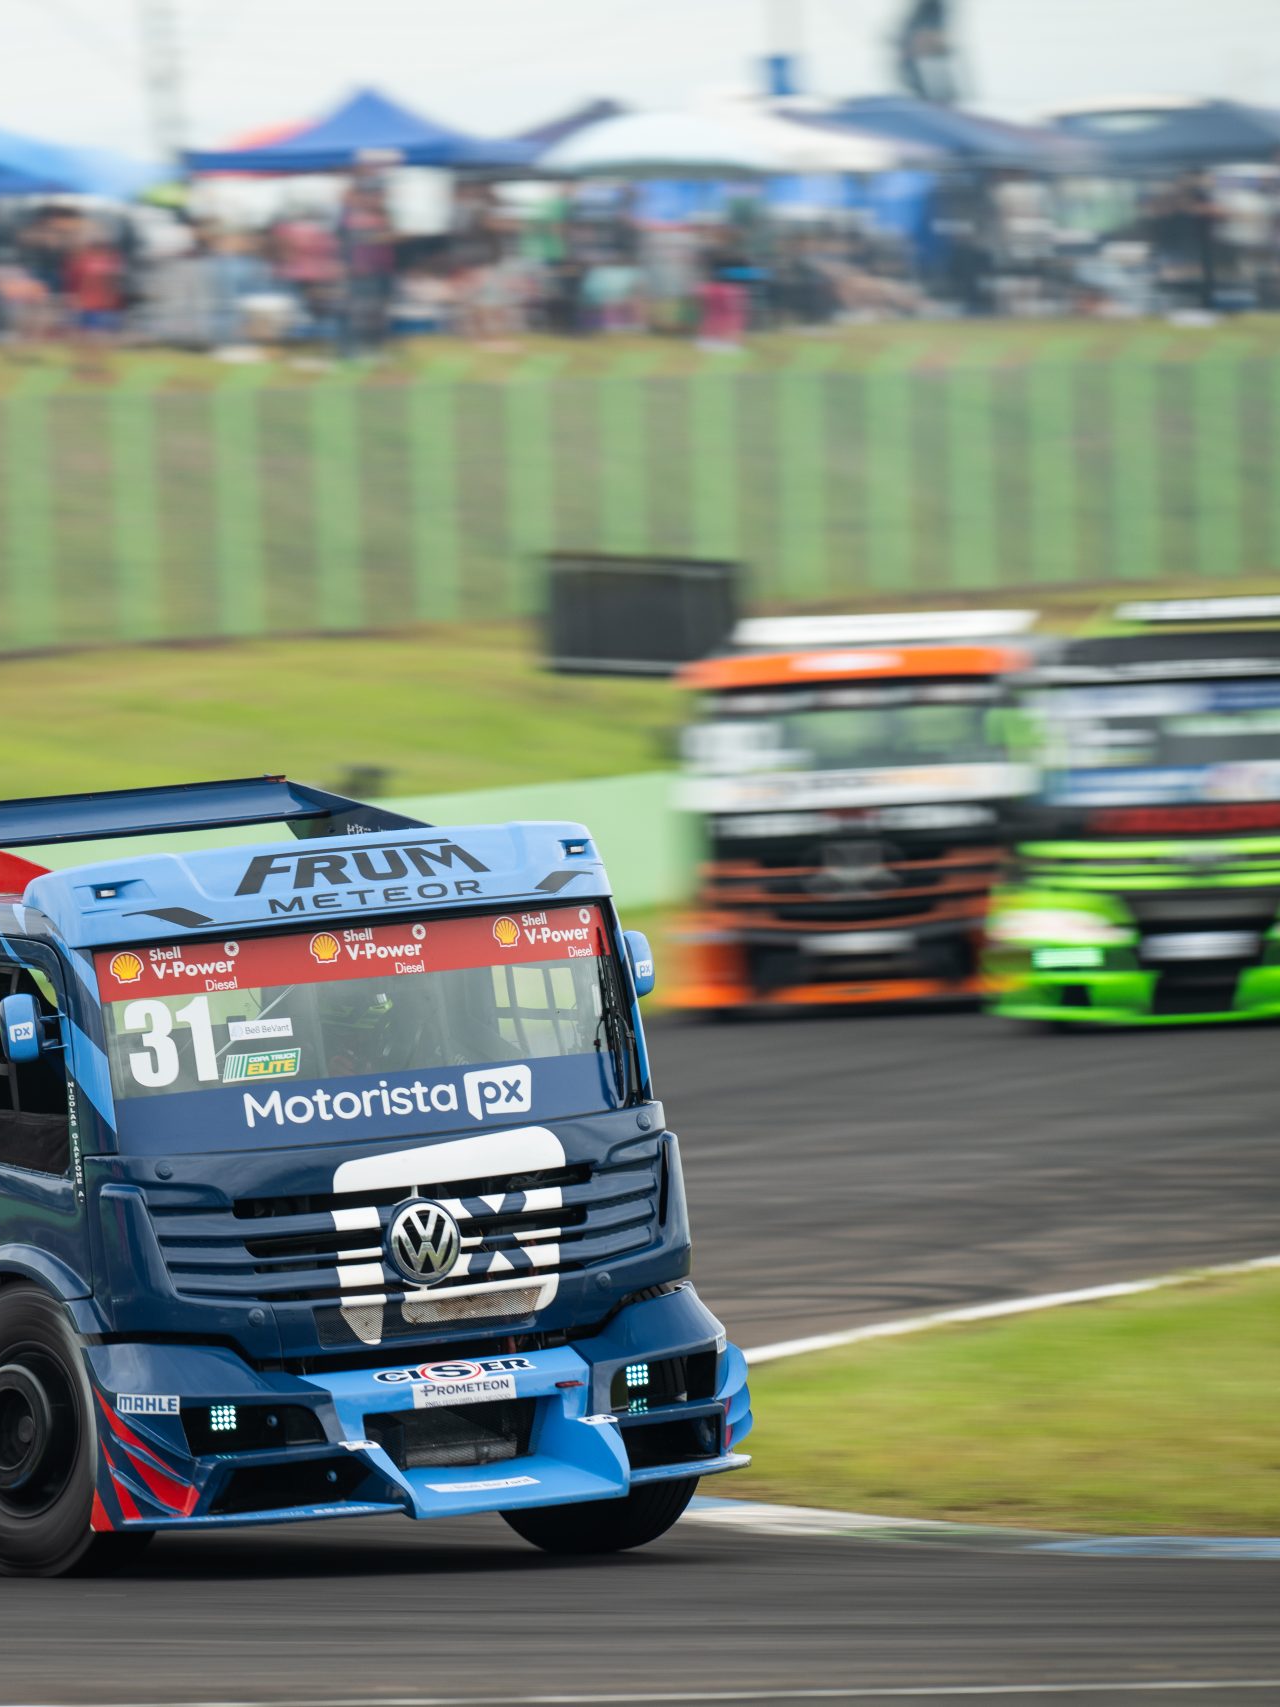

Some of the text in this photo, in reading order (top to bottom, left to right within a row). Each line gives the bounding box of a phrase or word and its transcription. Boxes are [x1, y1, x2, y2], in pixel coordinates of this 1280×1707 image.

[234, 838, 491, 897] FRUM
[267, 879, 484, 915] METEOR
[522, 912, 548, 927] Shell
[343, 927, 373, 942] Shell
[524, 927, 589, 945] V-Power
[149, 945, 181, 962] Shell
[345, 942, 423, 961] V-Power
[567, 943, 593, 958] Diesel
[151, 960, 236, 980] V-Power
[394, 959, 425, 974] Diesel
[205, 976, 238, 992] Diesel
[124, 995, 219, 1088] 31
[248, 1052, 297, 1063] COPA TRUCK
[246, 1059, 297, 1076] ELITE
[67, 1081, 78, 1127] NICOLAS
[243, 1079, 524, 1128] Motorista px
[375, 1358, 534, 1383] CISER
[421, 1379, 510, 1397] PROMETEON
[119, 1396, 178, 1412] MAHLE
